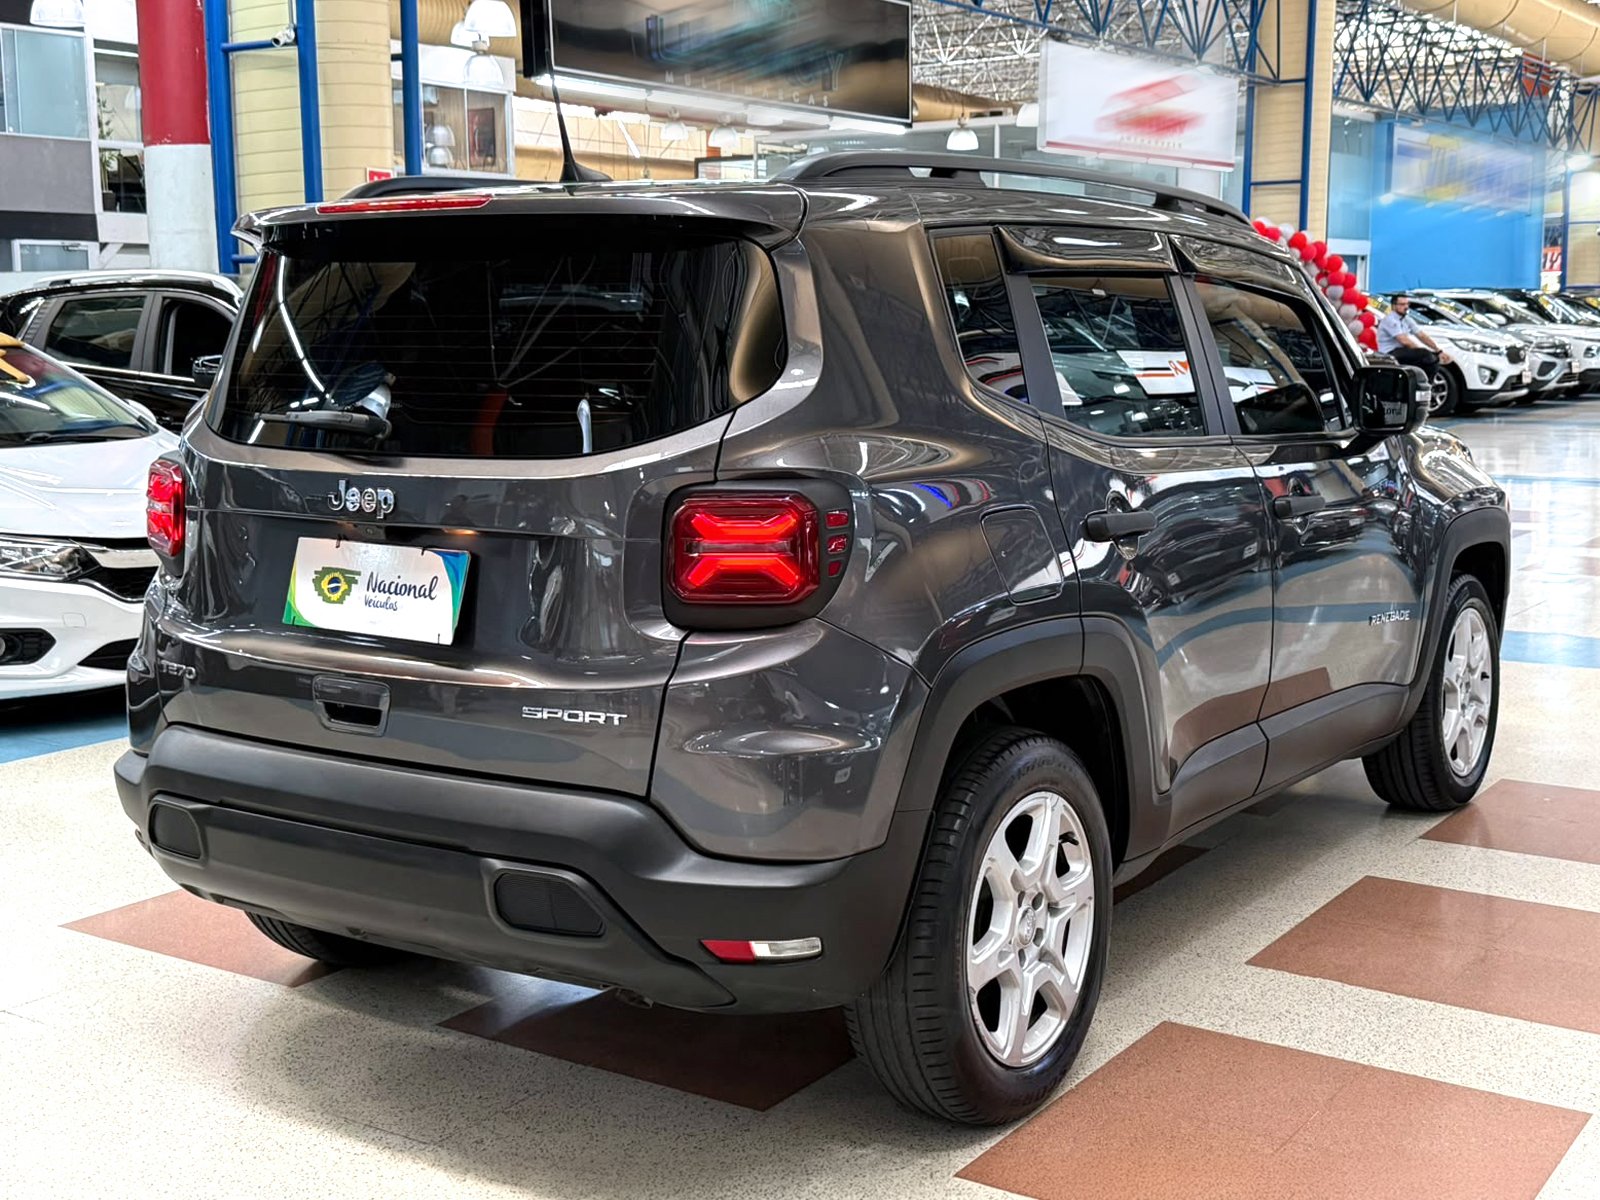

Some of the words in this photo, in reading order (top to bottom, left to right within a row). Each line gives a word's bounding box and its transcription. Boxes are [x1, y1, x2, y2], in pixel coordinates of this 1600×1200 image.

[326, 478, 395, 519] Jeep
[366, 571, 438, 600] Nacional
[1369, 609, 1411, 626] RENEGADE
[521, 706, 629, 726] SPORT
